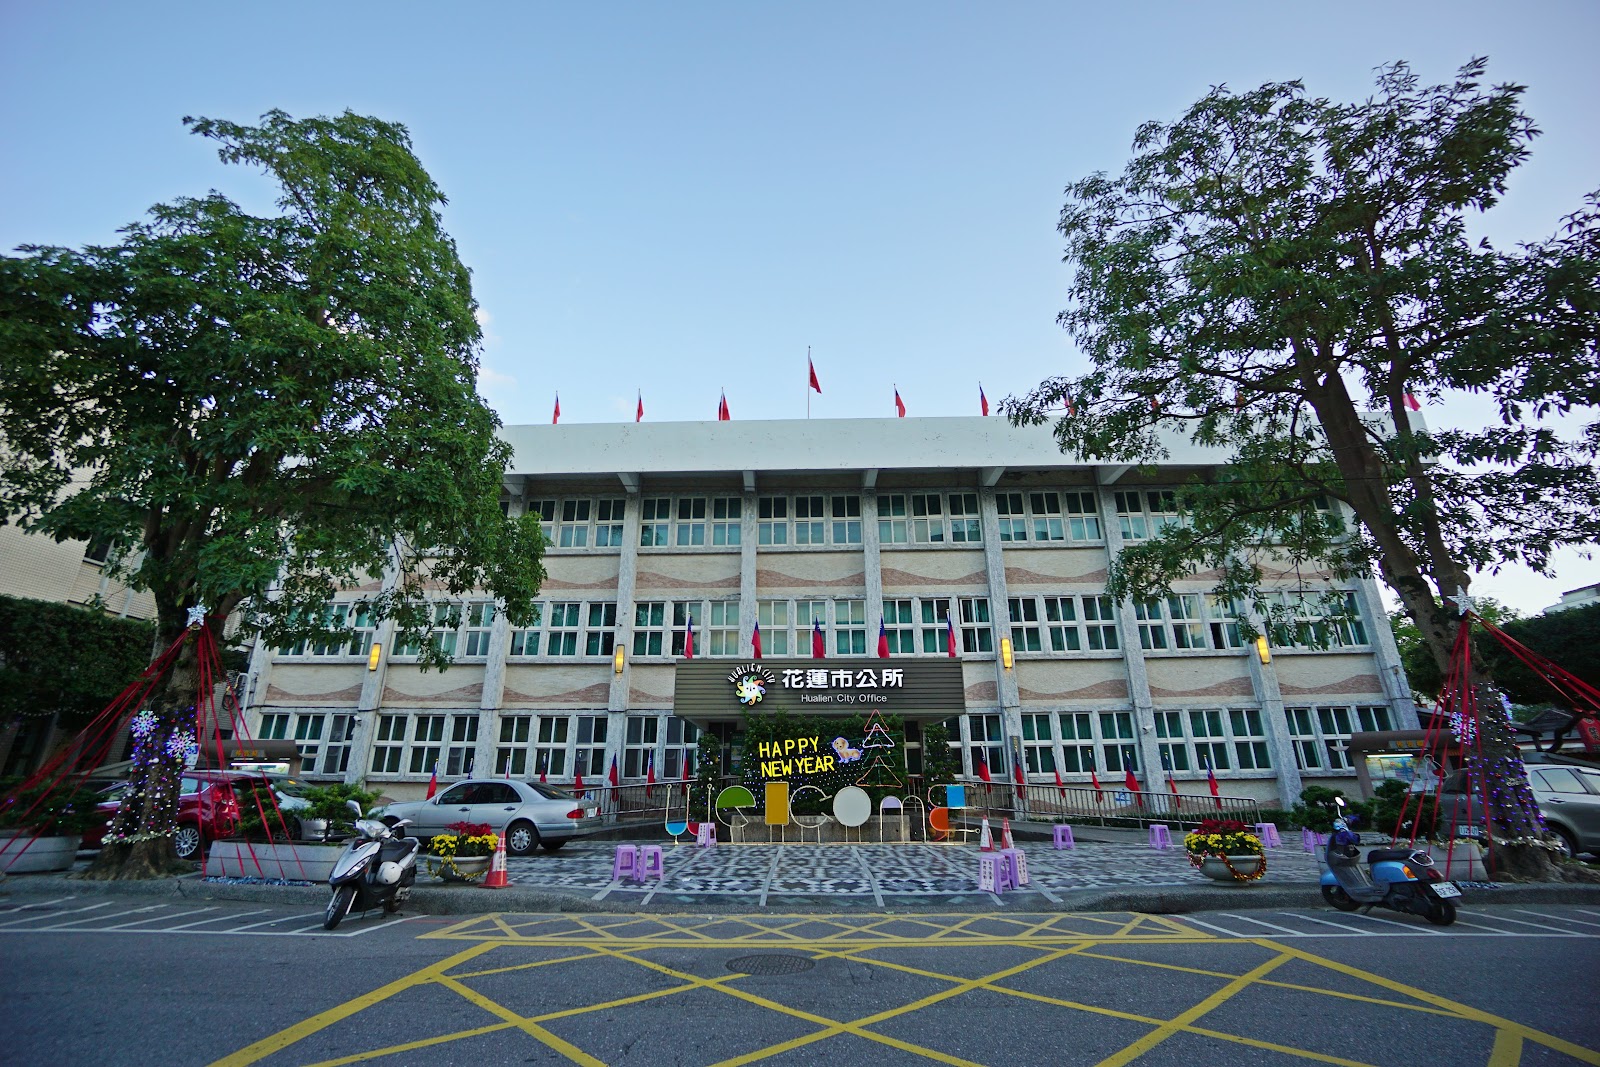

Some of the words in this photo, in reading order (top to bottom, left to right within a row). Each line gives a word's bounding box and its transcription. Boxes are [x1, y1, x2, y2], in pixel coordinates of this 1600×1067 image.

[727, 663, 762, 683] HUALIEN
[762, 669, 776, 683] CITY
[781, 668, 904, 689] 花蓮市公所
[801, 693, 833, 703] Hualien
[836, 693, 855, 704] City
[858, 693, 887, 703] Office
[759, 736, 819, 758] HAPPY
[761, 759, 793, 778] NEW
[795, 755, 835, 774] YEAR
